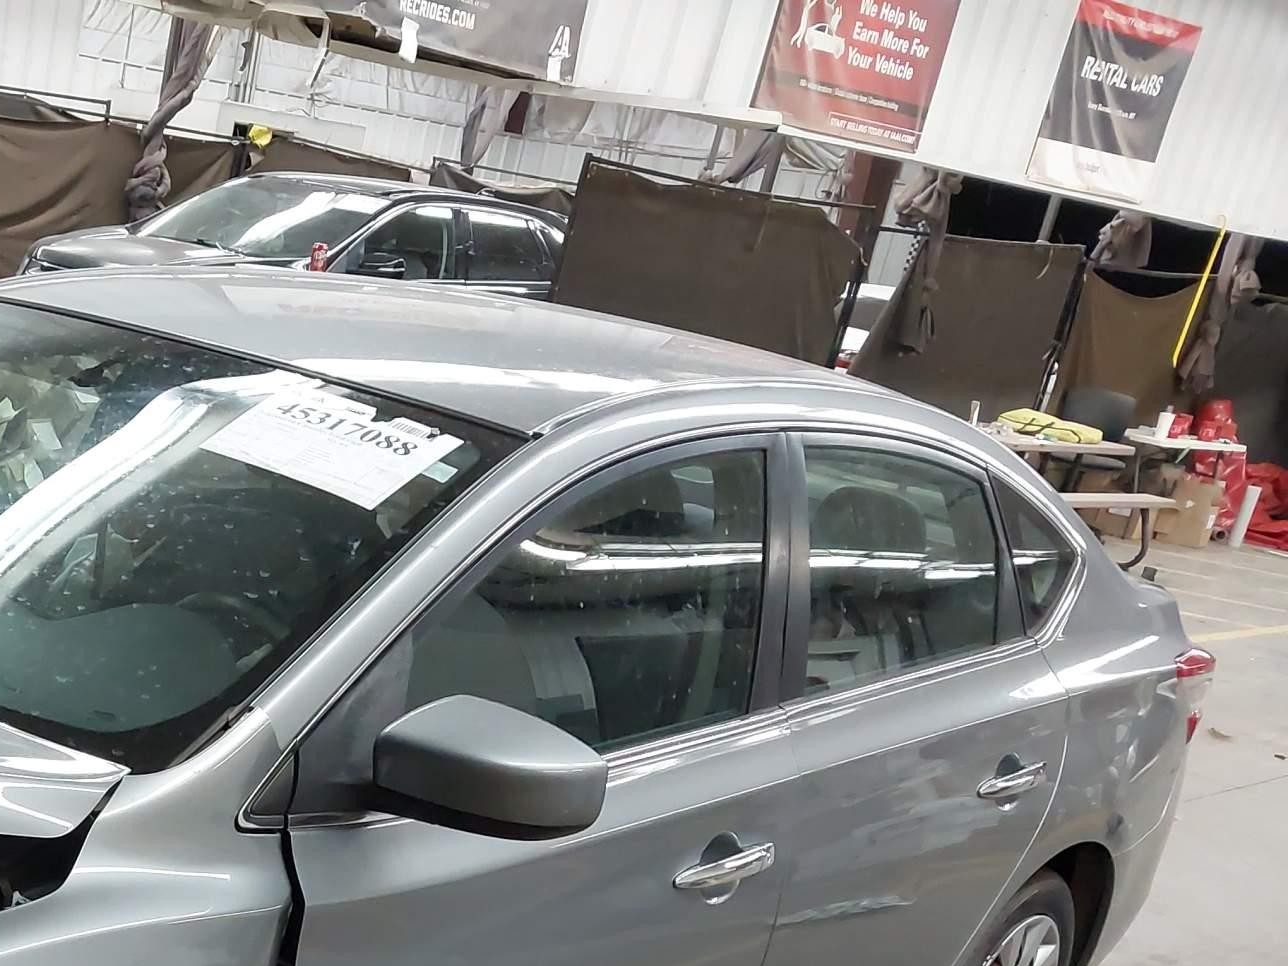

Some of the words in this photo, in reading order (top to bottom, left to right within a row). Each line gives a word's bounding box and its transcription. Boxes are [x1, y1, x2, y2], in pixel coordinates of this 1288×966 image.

[399, 0, 476, 30] RECRIDES.COM
[860, 0, 878, 17] We
[880, 2, 905, 29] Help
[907, 10, 928, 32] You
[852, 21, 879, 45] Earn
[880, 29, 910, 53] More
[910, 38, 930, 59] For
[847, 46, 873, 70] Your
[875, 53, 914, 80] Vehicle
[1081, 56, 1128, 89] RENTAL
[1130, 72, 1164, 97] CARS
[276, 402, 419, 456] 45317088
